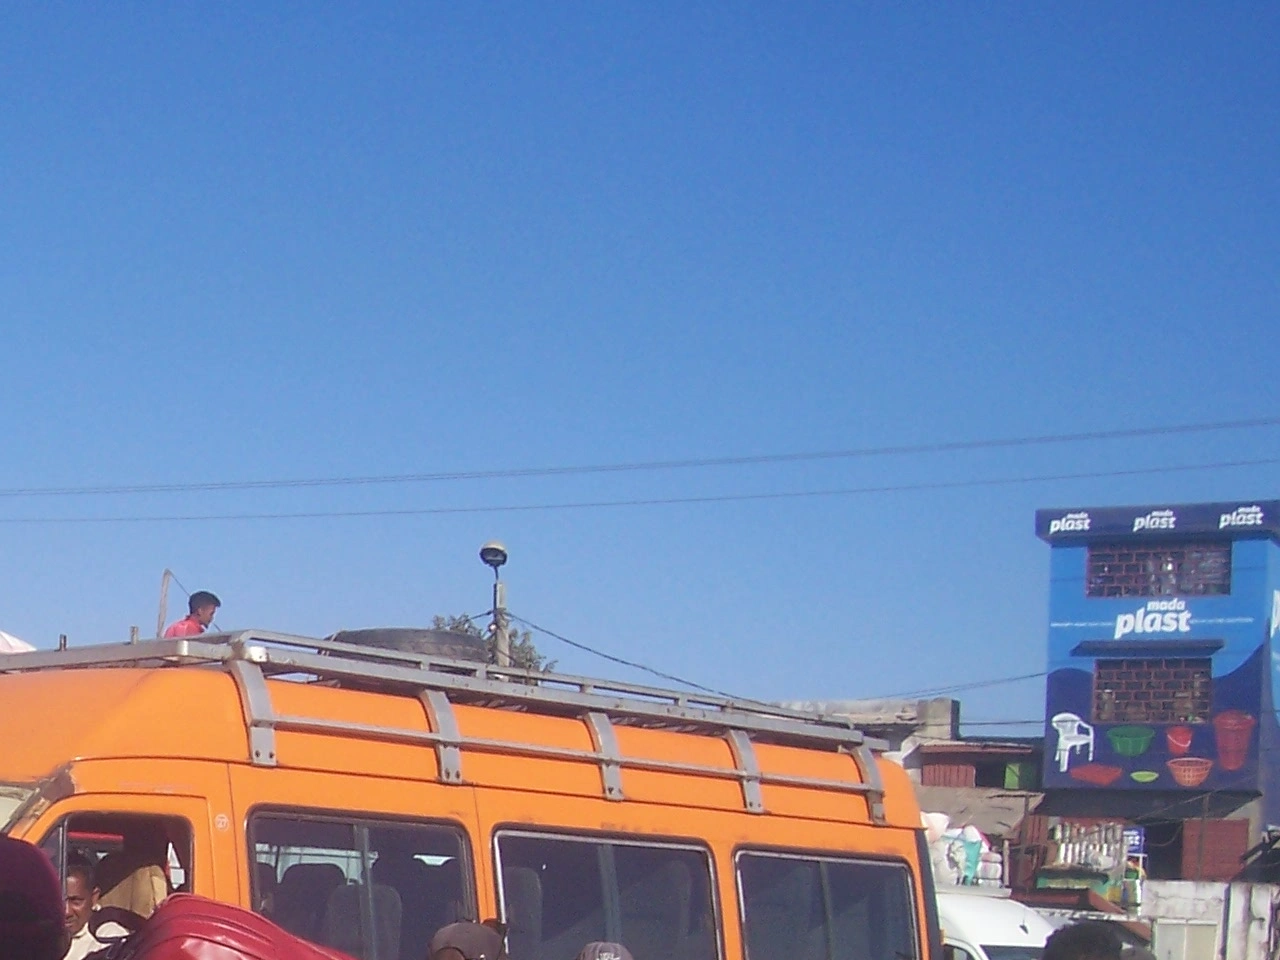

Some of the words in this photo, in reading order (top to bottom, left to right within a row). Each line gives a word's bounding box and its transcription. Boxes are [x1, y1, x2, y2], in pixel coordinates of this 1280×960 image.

[1049, 517, 1091, 535] plast
[1133, 514, 1177, 532] plast
[1219, 511, 1264, 529] plast
[1146, 598, 1186, 611] mada
[1114, 607, 1192, 639] plast
